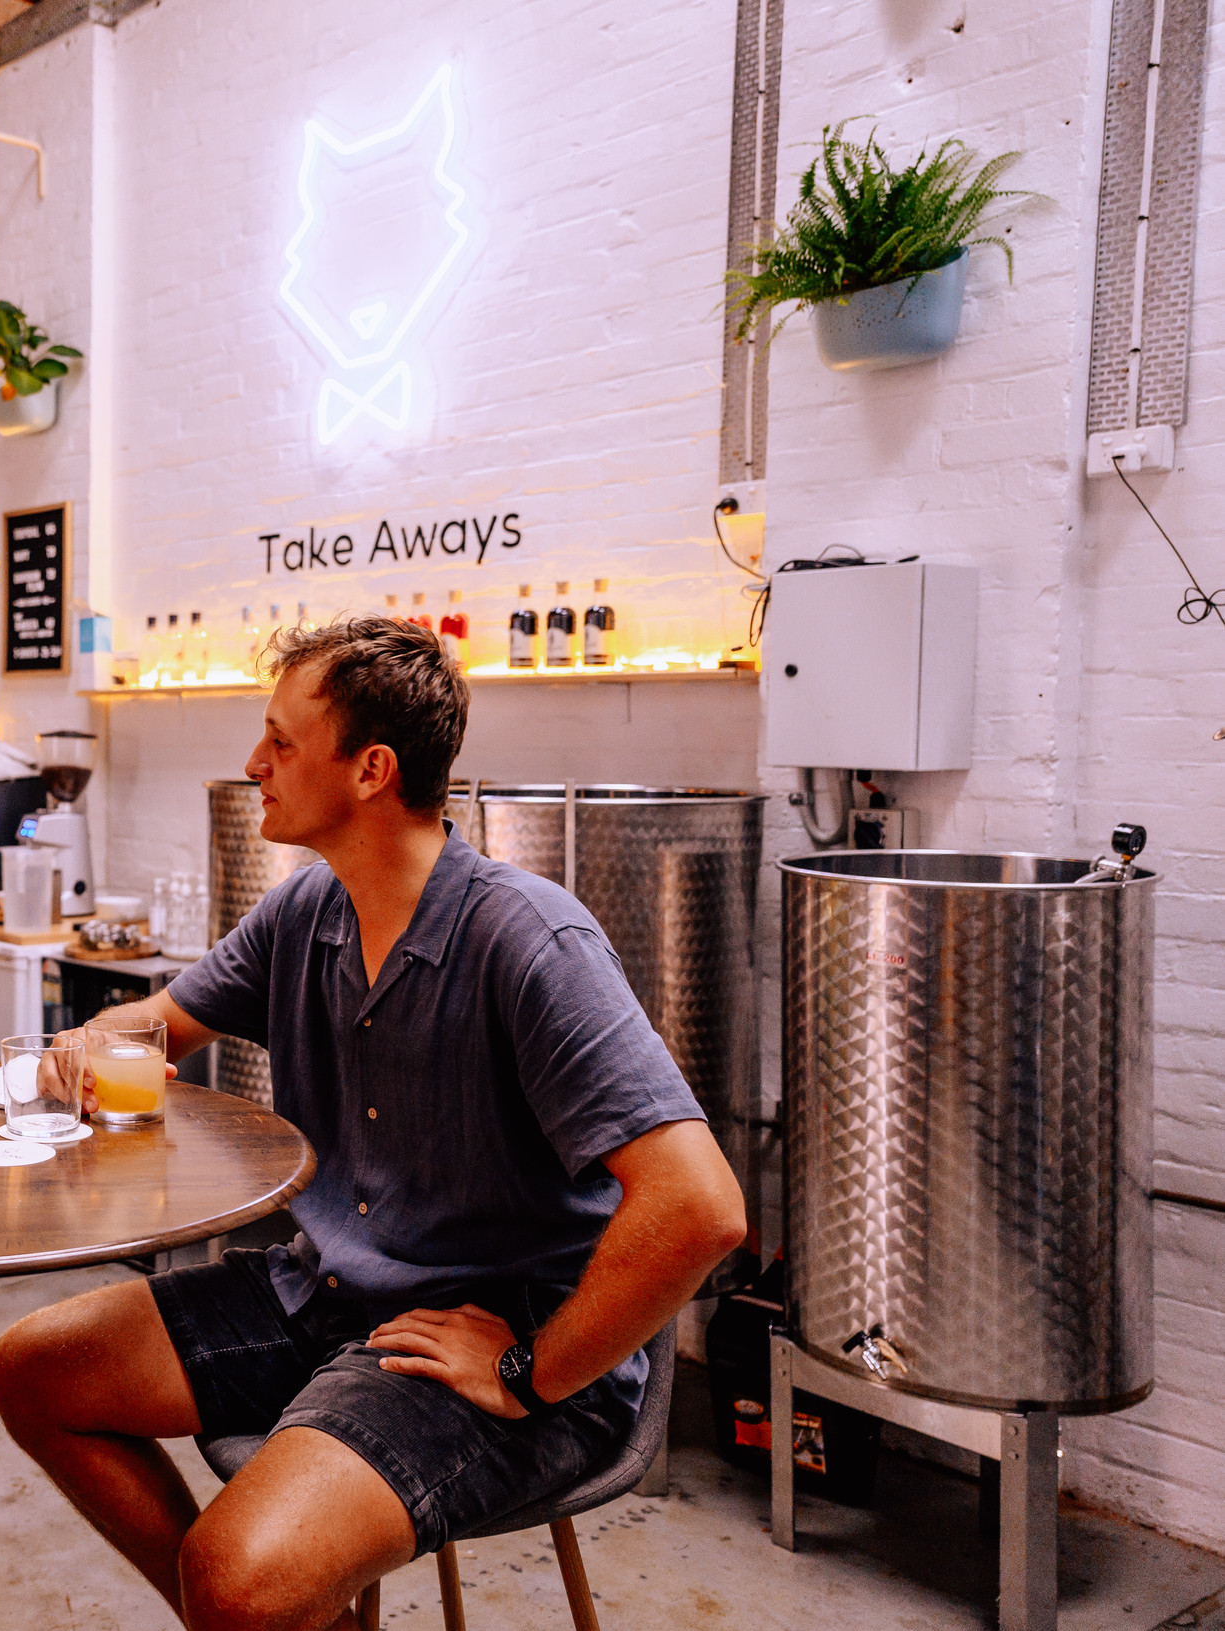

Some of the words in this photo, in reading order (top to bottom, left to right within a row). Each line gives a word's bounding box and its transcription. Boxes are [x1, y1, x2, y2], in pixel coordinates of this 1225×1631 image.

[258, 527, 354, 573] Take
[369, 513, 521, 565] Aways
[883, 952, 905, 965] 200
